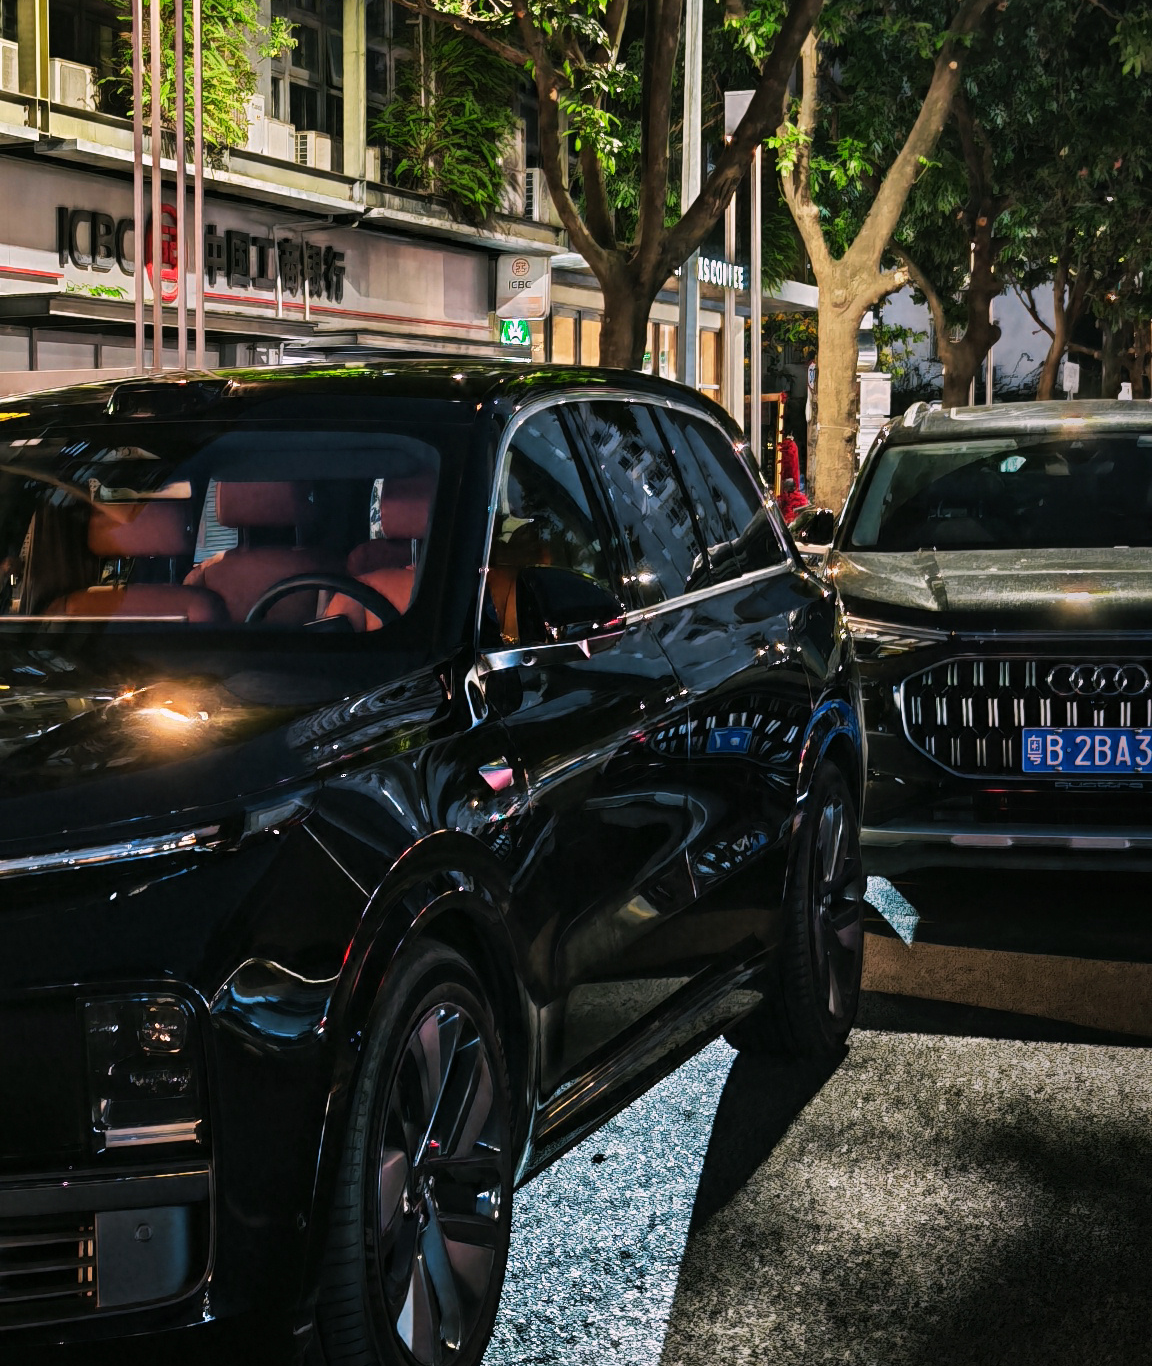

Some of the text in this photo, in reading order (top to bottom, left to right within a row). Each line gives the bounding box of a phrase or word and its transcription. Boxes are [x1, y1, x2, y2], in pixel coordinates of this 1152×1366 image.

[55, 206, 135, 277] ICBC
[204, 224, 346, 304] 中国工商银行
[508, 280, 532, 290] ICBC
